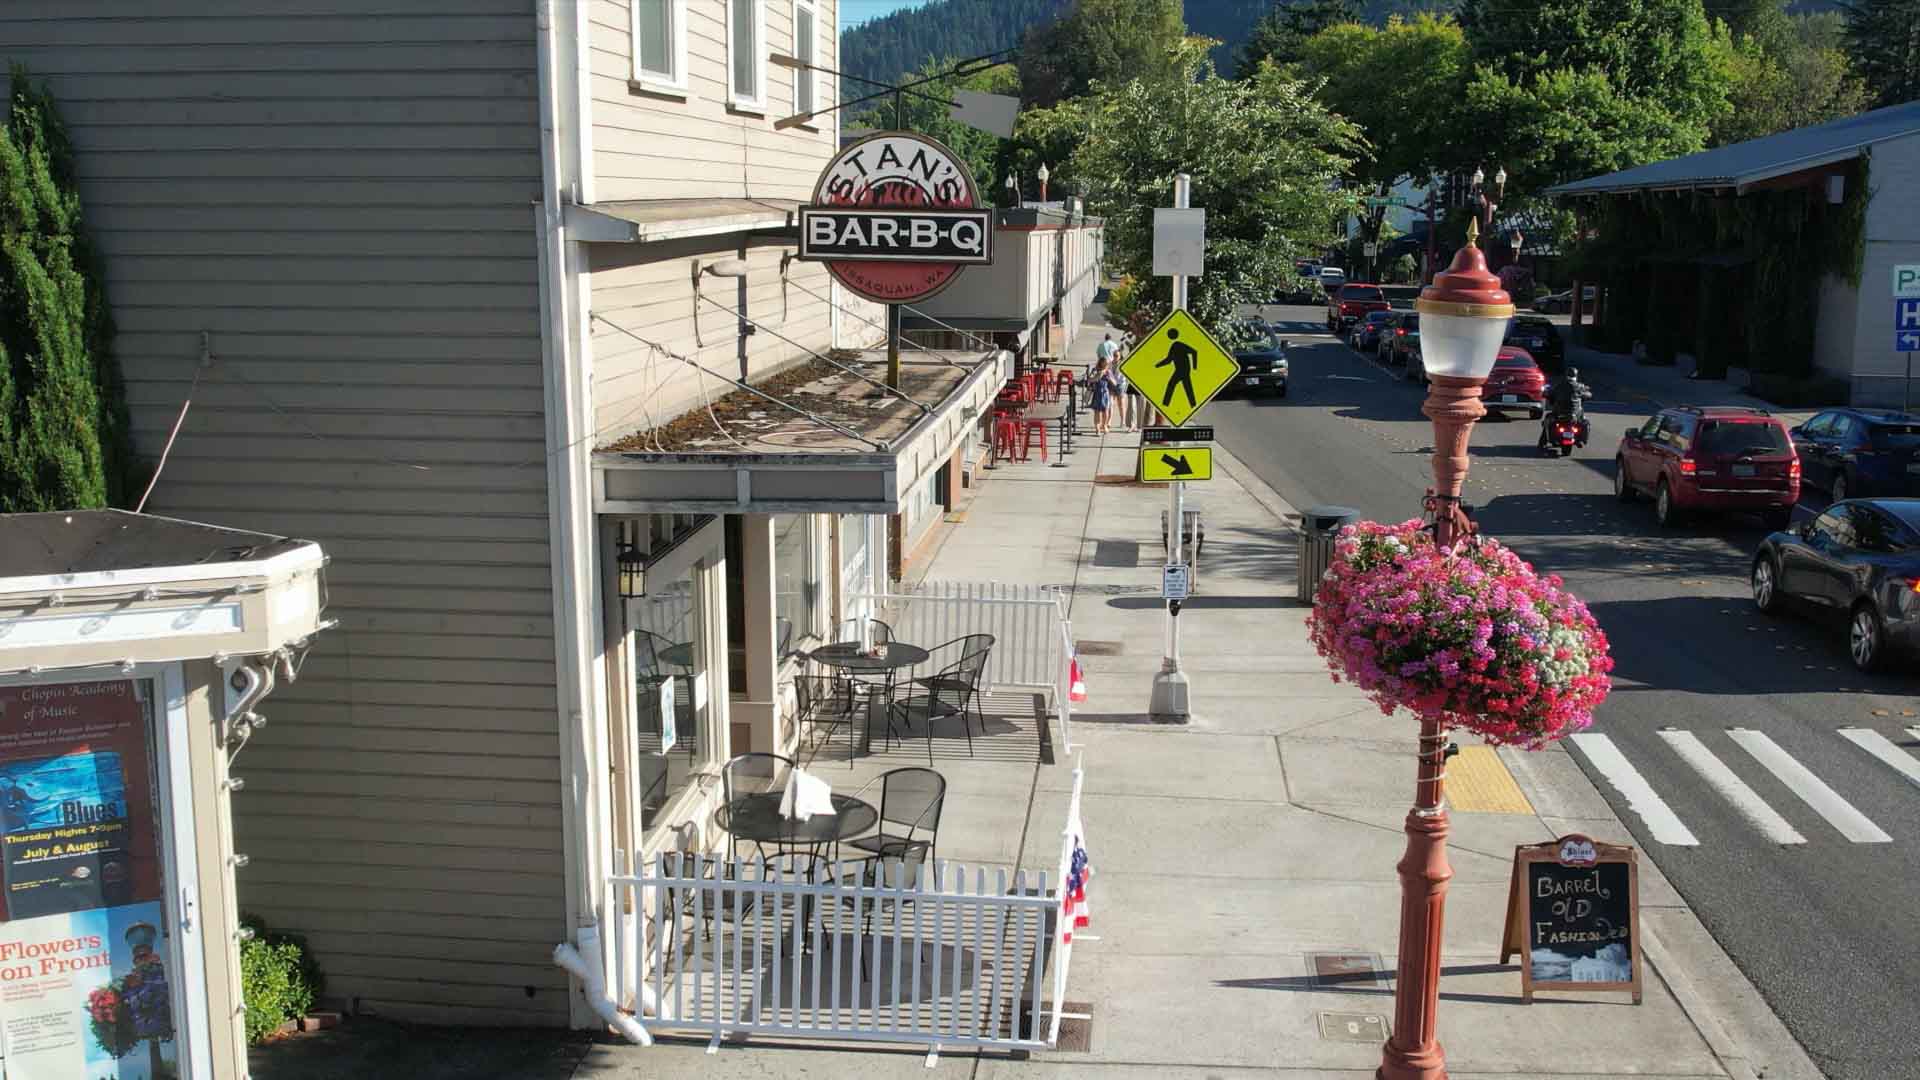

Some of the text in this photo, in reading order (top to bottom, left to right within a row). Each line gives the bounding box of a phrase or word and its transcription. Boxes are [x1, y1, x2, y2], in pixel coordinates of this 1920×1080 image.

[827, 143, 961, 202] STAN'S
[809, 216, 982, 254] BAR-B-Q
[62, 799, 118, 825] Blues
[5, 833, 53, 844] Thursday
[55, 828, 88, 838] Nights
[22, 847, 50, 859] July
[52, 845, 63, 855] &
[66, 840, 110, 853] August
[0, 936, 101, 961] Flowers
[1, 950, 112, 980] on Front
